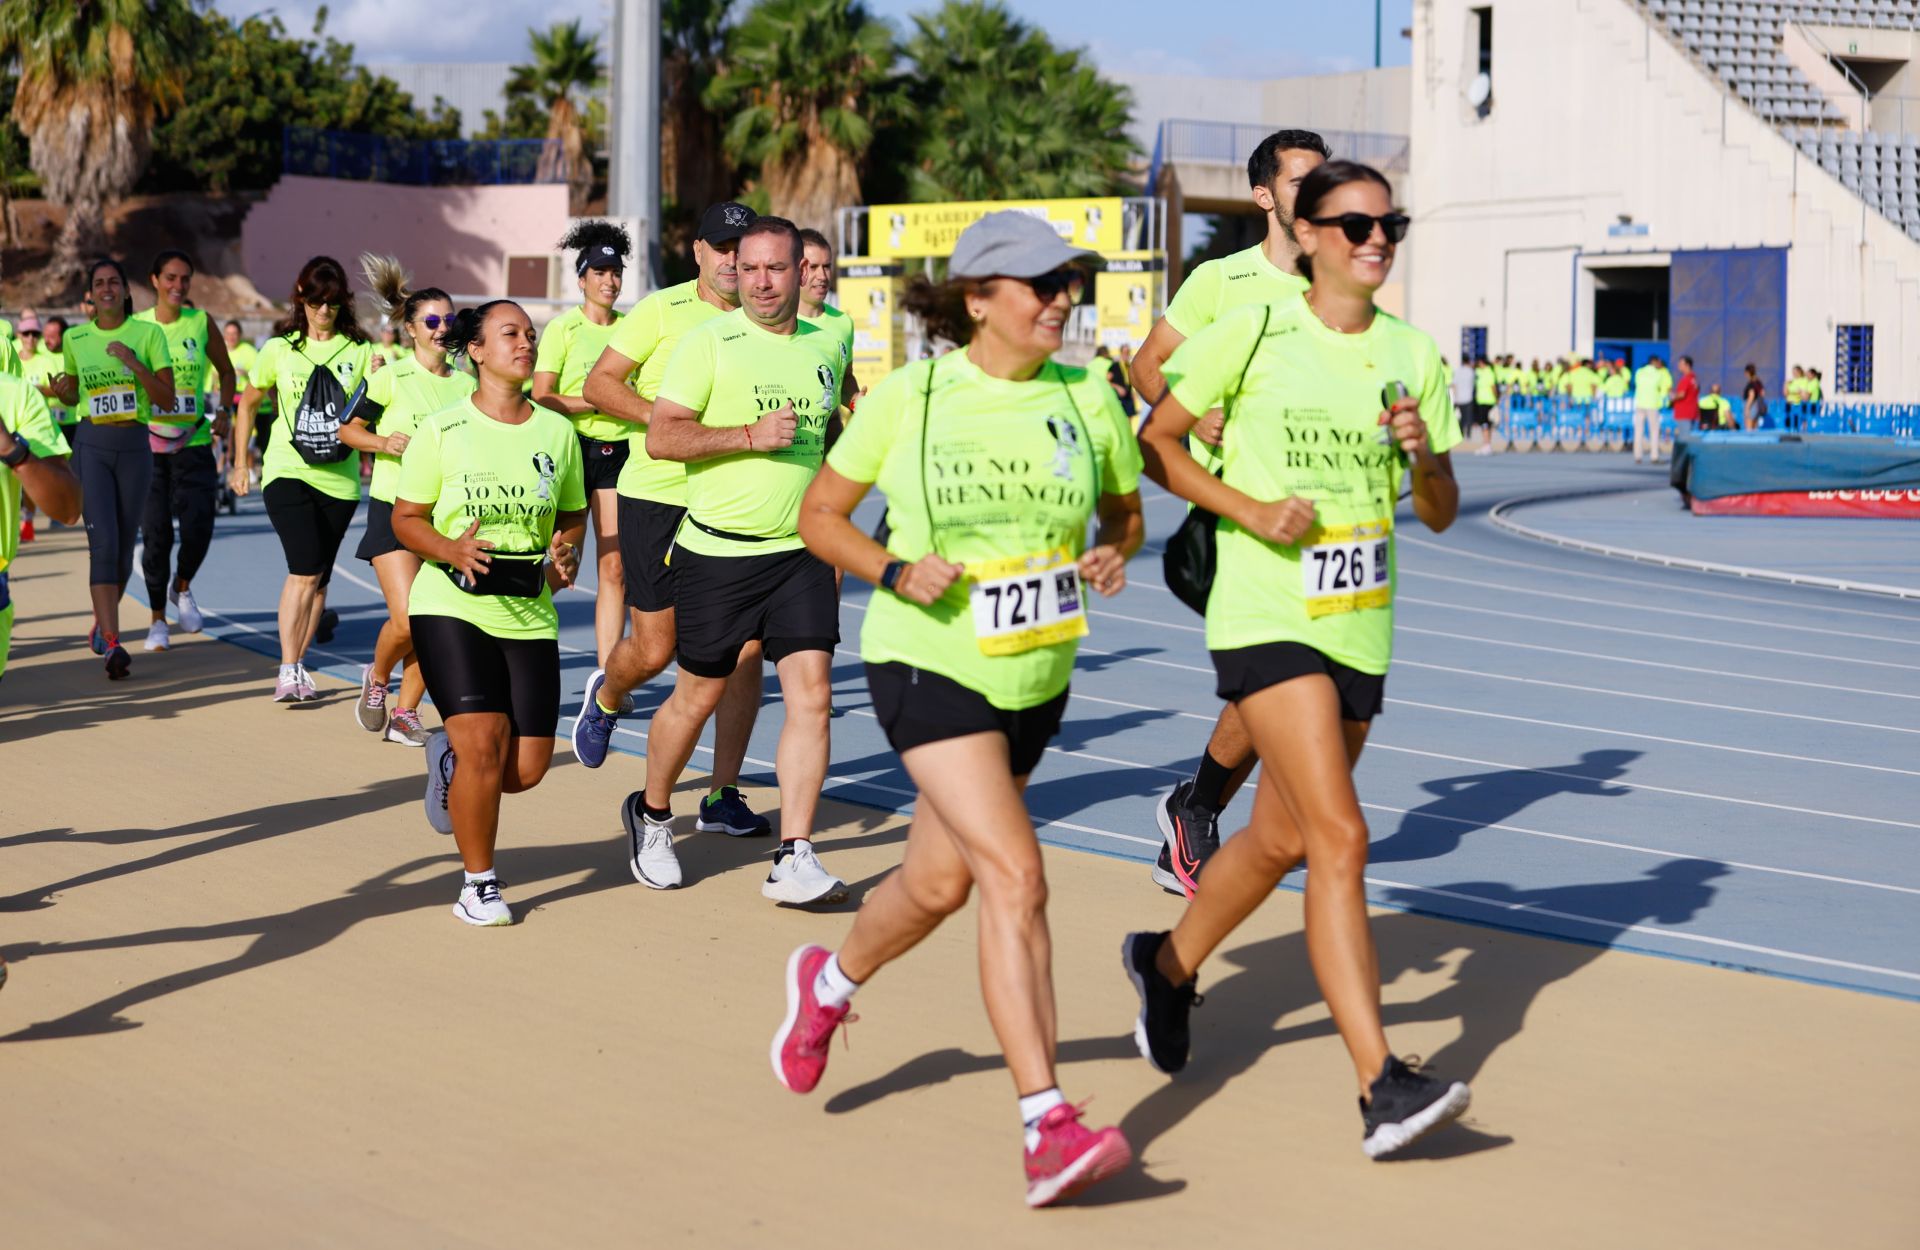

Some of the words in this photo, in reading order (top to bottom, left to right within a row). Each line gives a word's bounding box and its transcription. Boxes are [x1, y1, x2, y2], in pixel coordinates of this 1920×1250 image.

[94, 394, 118, 415] 750
[756, 397, 780, 411] YO
[440, 421, 461, 433] luanvi
[1285, 426, 1319, 444] YO
[1328, 427, 1364, 448] NO
[934, 460, 974, 479] YO
[988, 457, 1030, 477] NO
[464, 486, 490, 500] YO
[498, 484, 525, 499] NO
[936, 481, 1085, 507] RENUNCIO
[464, 502, 553, 518] RENUNCIO
[1313, 546, 1364, 591] 726
[984, 578, 1041, 629] 727
